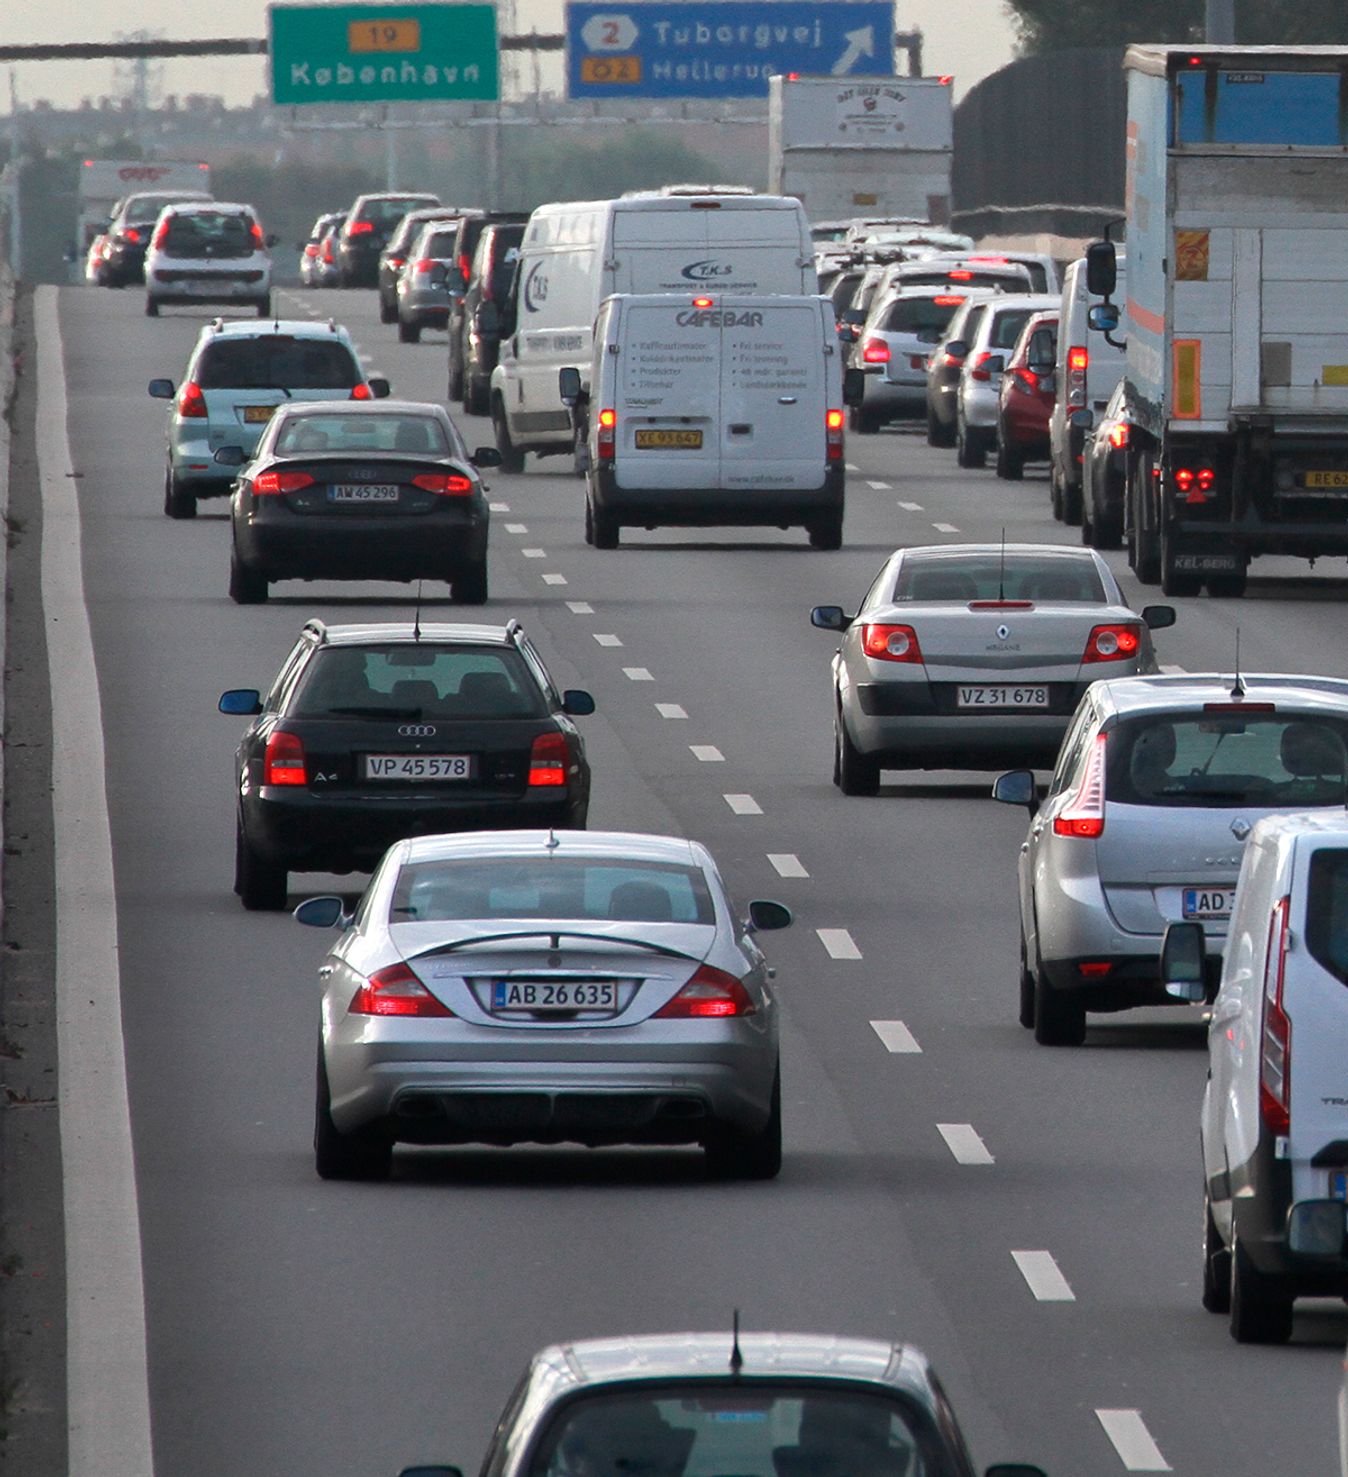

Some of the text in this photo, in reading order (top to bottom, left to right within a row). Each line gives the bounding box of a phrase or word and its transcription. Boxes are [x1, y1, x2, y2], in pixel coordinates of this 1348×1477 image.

[369, 26, 398, 44] 19
[601, 22, 620, 45] 2
[653, 19, 821, 48] Tuborgvej
[291, 61, 480, 86] København
[1314, 474, 1331, 485] RE
[1334, 474, 1348, 485] 62
[335, 485, 396, 498] AW 45 296
[961, 690, 1045, 703] VZ 31 678
[370, 759, 465, 775] VP 45 578
[1198, 893, 1224, 911] AD
[508, 985, 612, 1004] AB 26 635
